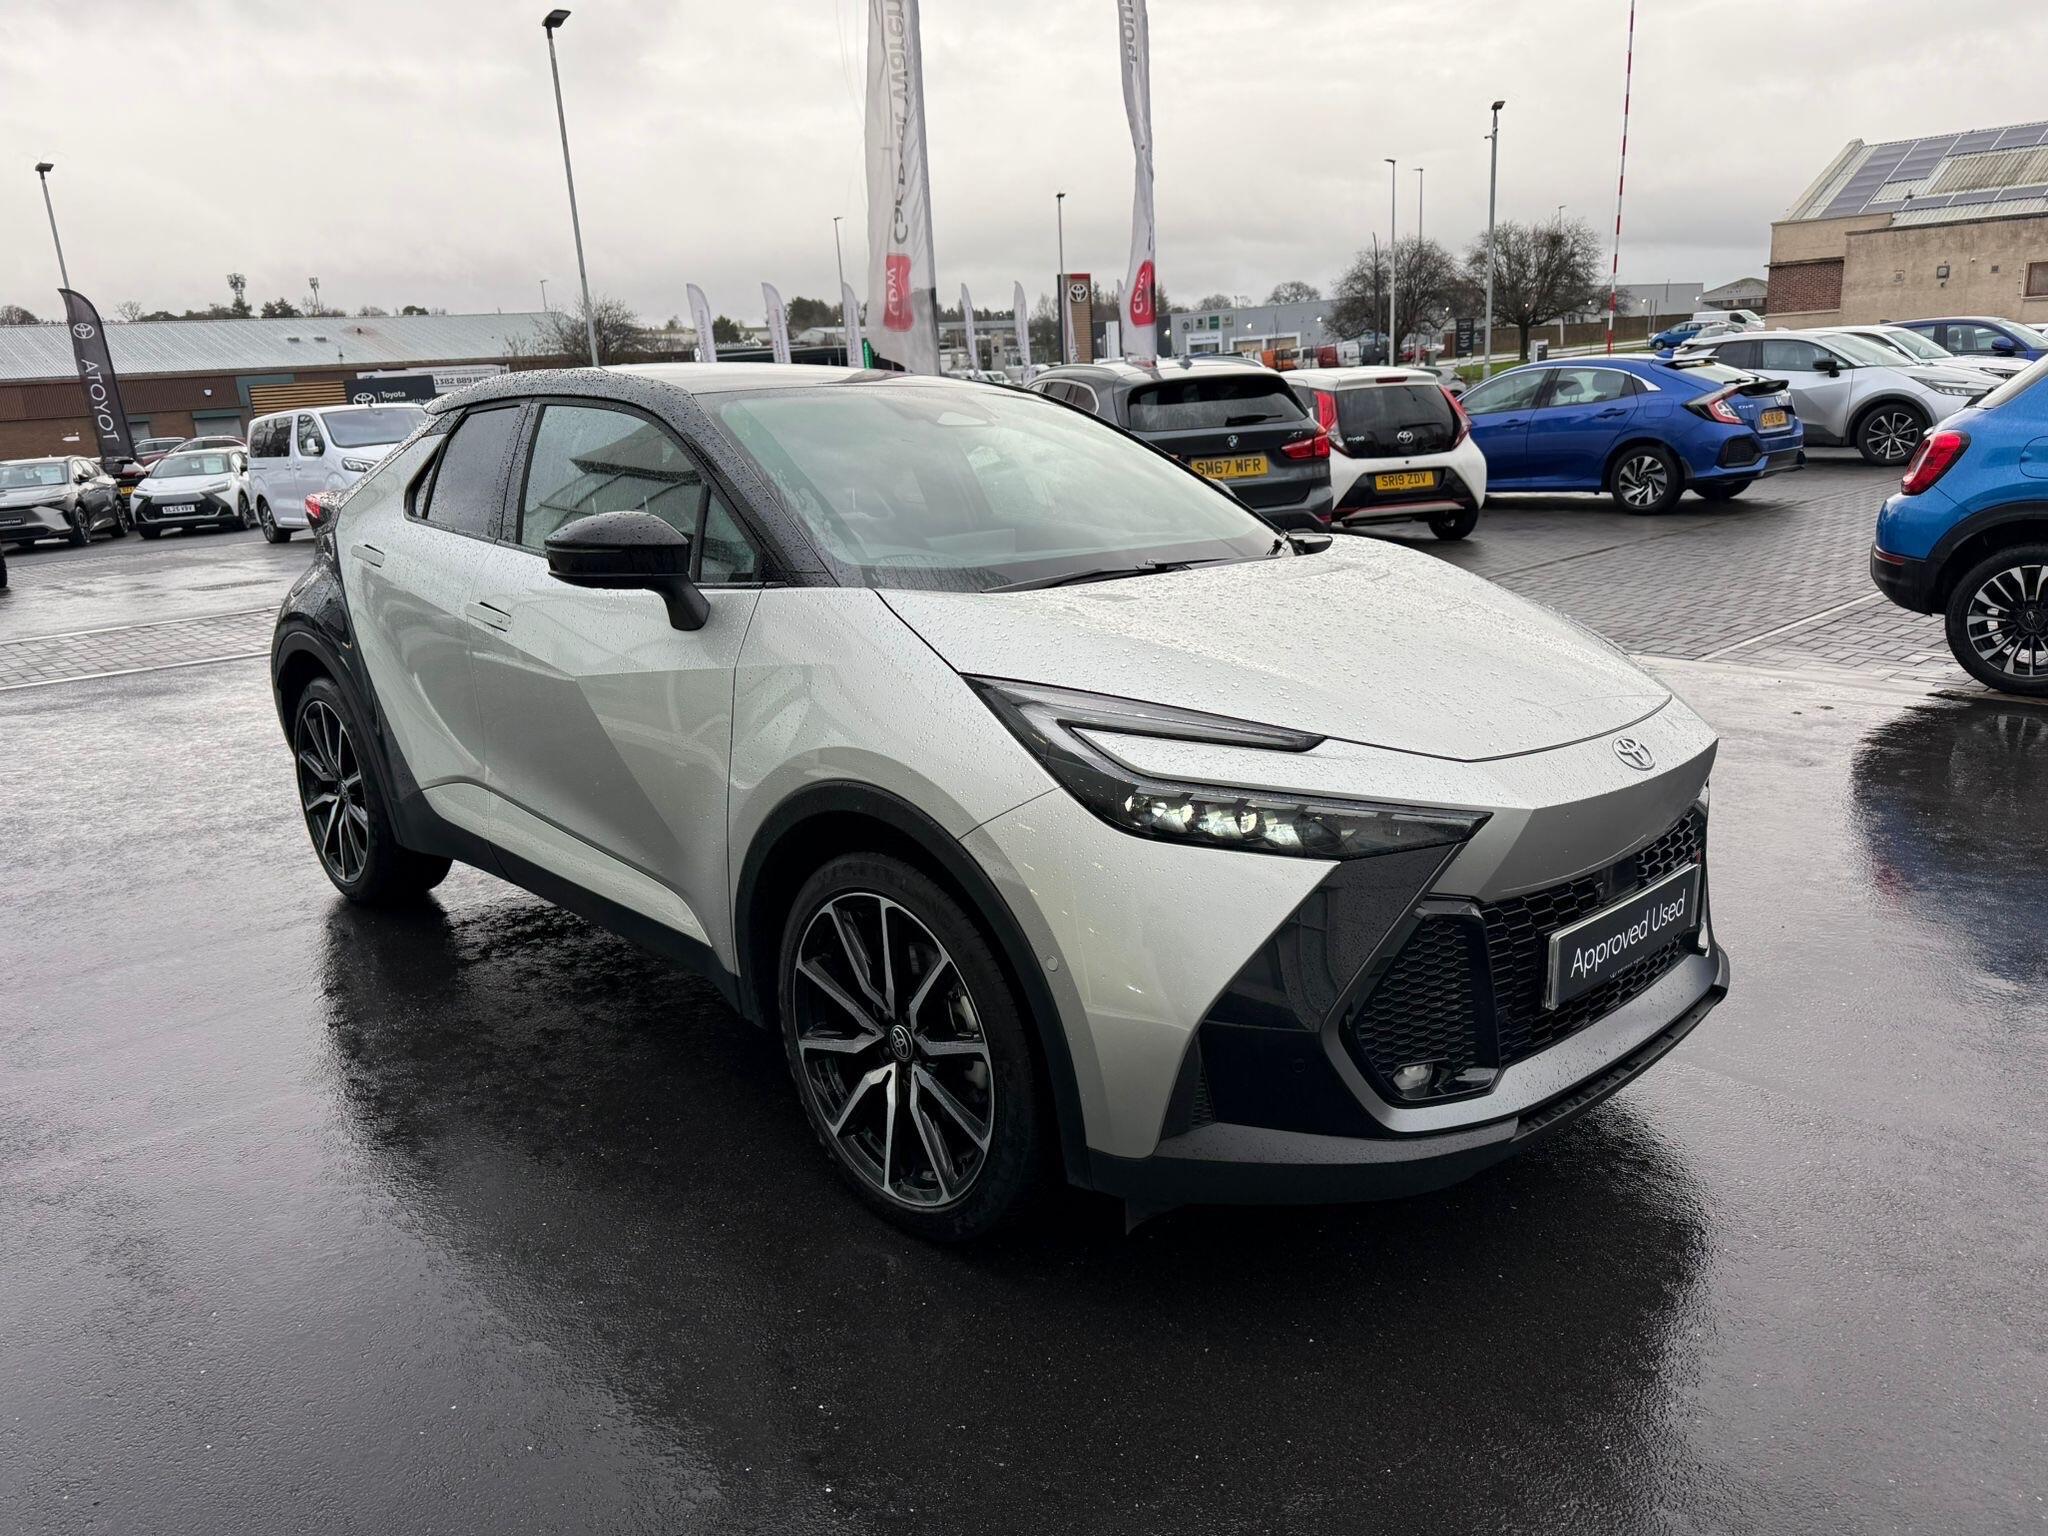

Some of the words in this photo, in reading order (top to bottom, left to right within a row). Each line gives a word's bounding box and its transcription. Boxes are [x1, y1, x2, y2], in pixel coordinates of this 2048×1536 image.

[381, 391, 406, 399] Toyota
[1196, 461, 1231, 475] SM67
[1381, 475, 1404, 487] SR19
[1407, 473, 1426, 485] ZDV
[1570, 909, 1649, 979] Approved
[1652, 888, 1686, 932] Used
